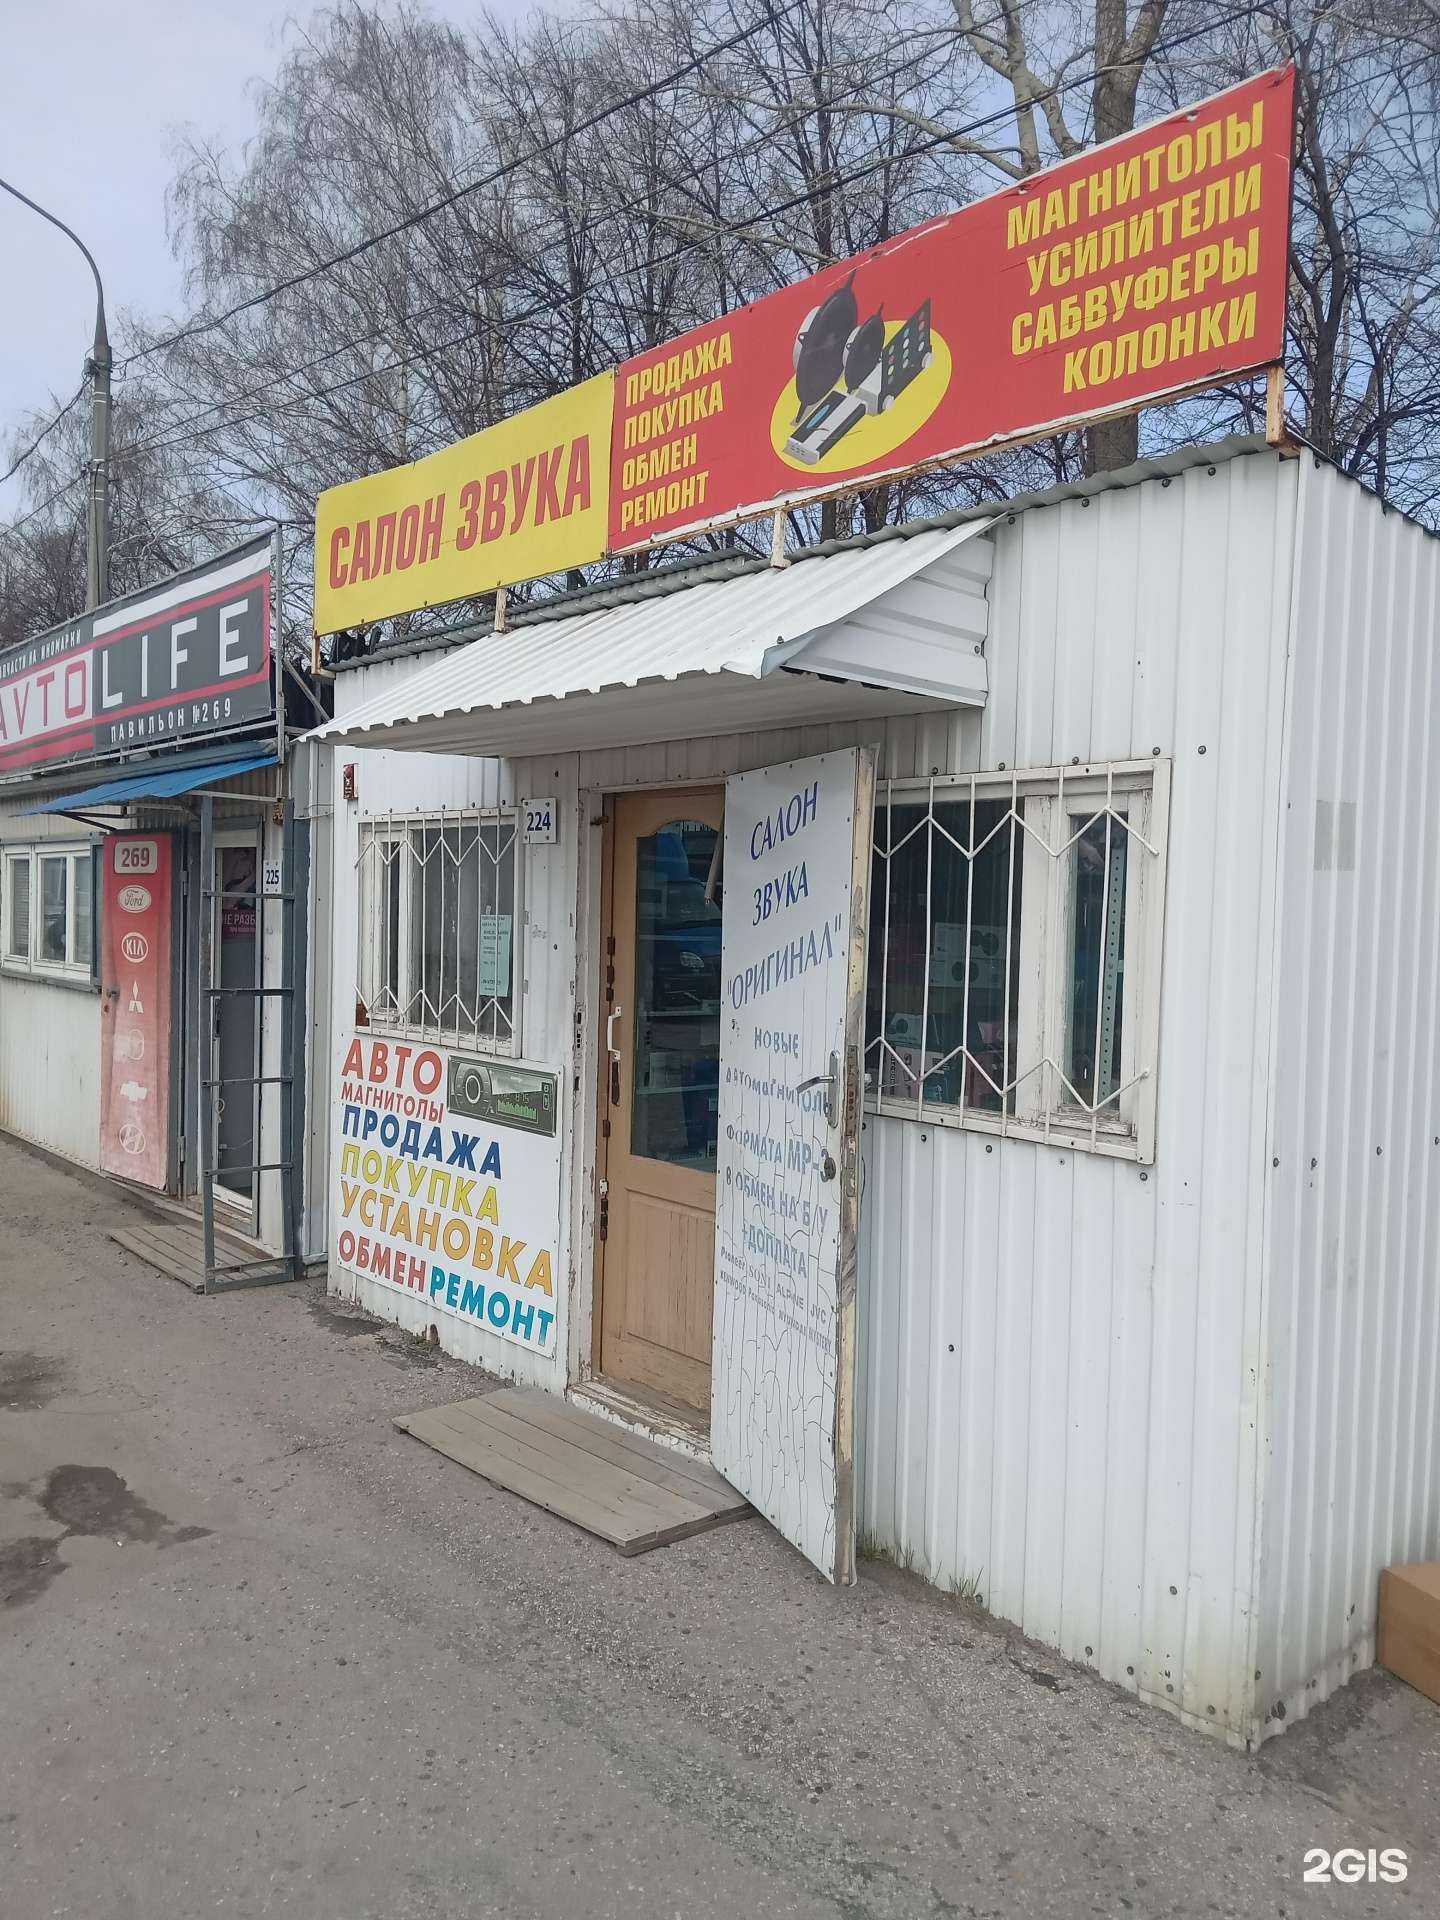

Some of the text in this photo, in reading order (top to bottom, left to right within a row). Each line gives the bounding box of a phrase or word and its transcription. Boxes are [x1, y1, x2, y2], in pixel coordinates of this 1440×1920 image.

[1006, 100, 1265, 250] МАГНИТОЛЫ
[1026, 163, 1262, 297] УСИЛИТЕЛИ
[1010, 226, 1260, 357] САБВУФЕРЫ
[625, 331, 733, 408] ПРОДАЖА
[1063, 291, 1257, 394] КОЛОНКИ
[624, 379, 724, 450] ПОКУПКА
[622, 432, 698, 492] ОБМЕН
[328, 433, 591, 590] САЛОН ЗВУКА
[621, 470, 709, 533] РЕМОНТ
[41, 628, 81, 661] ИНОМАРКИ
[102, 598, 249, 709] LIFE
[111, 707, 185, 743] ПАВИЛЬОН
[527, 811, 551, 833] 224
[750, 781, 818, 861] САЛОН
[121, 847, 150, 868] 269
[265, 869, 279, 885] 225
[752, 861, 809, 927] ЗВУКА
[126, 939, 144, 956] KIA
[727, 913, 842, 1010] "ОРИГИНАЛ"
[341, 1038, 443, 1096] АВТО
[754, 1027, 799, 1058] НОВЫЕ
[341, 1081, 445, 1124] МАГНИТОЛЫ
[342, 1104, 502, 1180] ПРОДАЖА
[727, 1124, 782, 1164] ФОРМАТА
[340, 1142, 499, 1226] ПОКУПКА
[735, 1171, 775, 1211] ОБМЕН
[780, 1190, 798, 1222] НА
[340, 1180, 553, 1297] УСТАНОВКА
[338, 1230, 554, 1347] ОБМЕН РЕМОНТ
[810, 1303, 826, 1324] JVC
